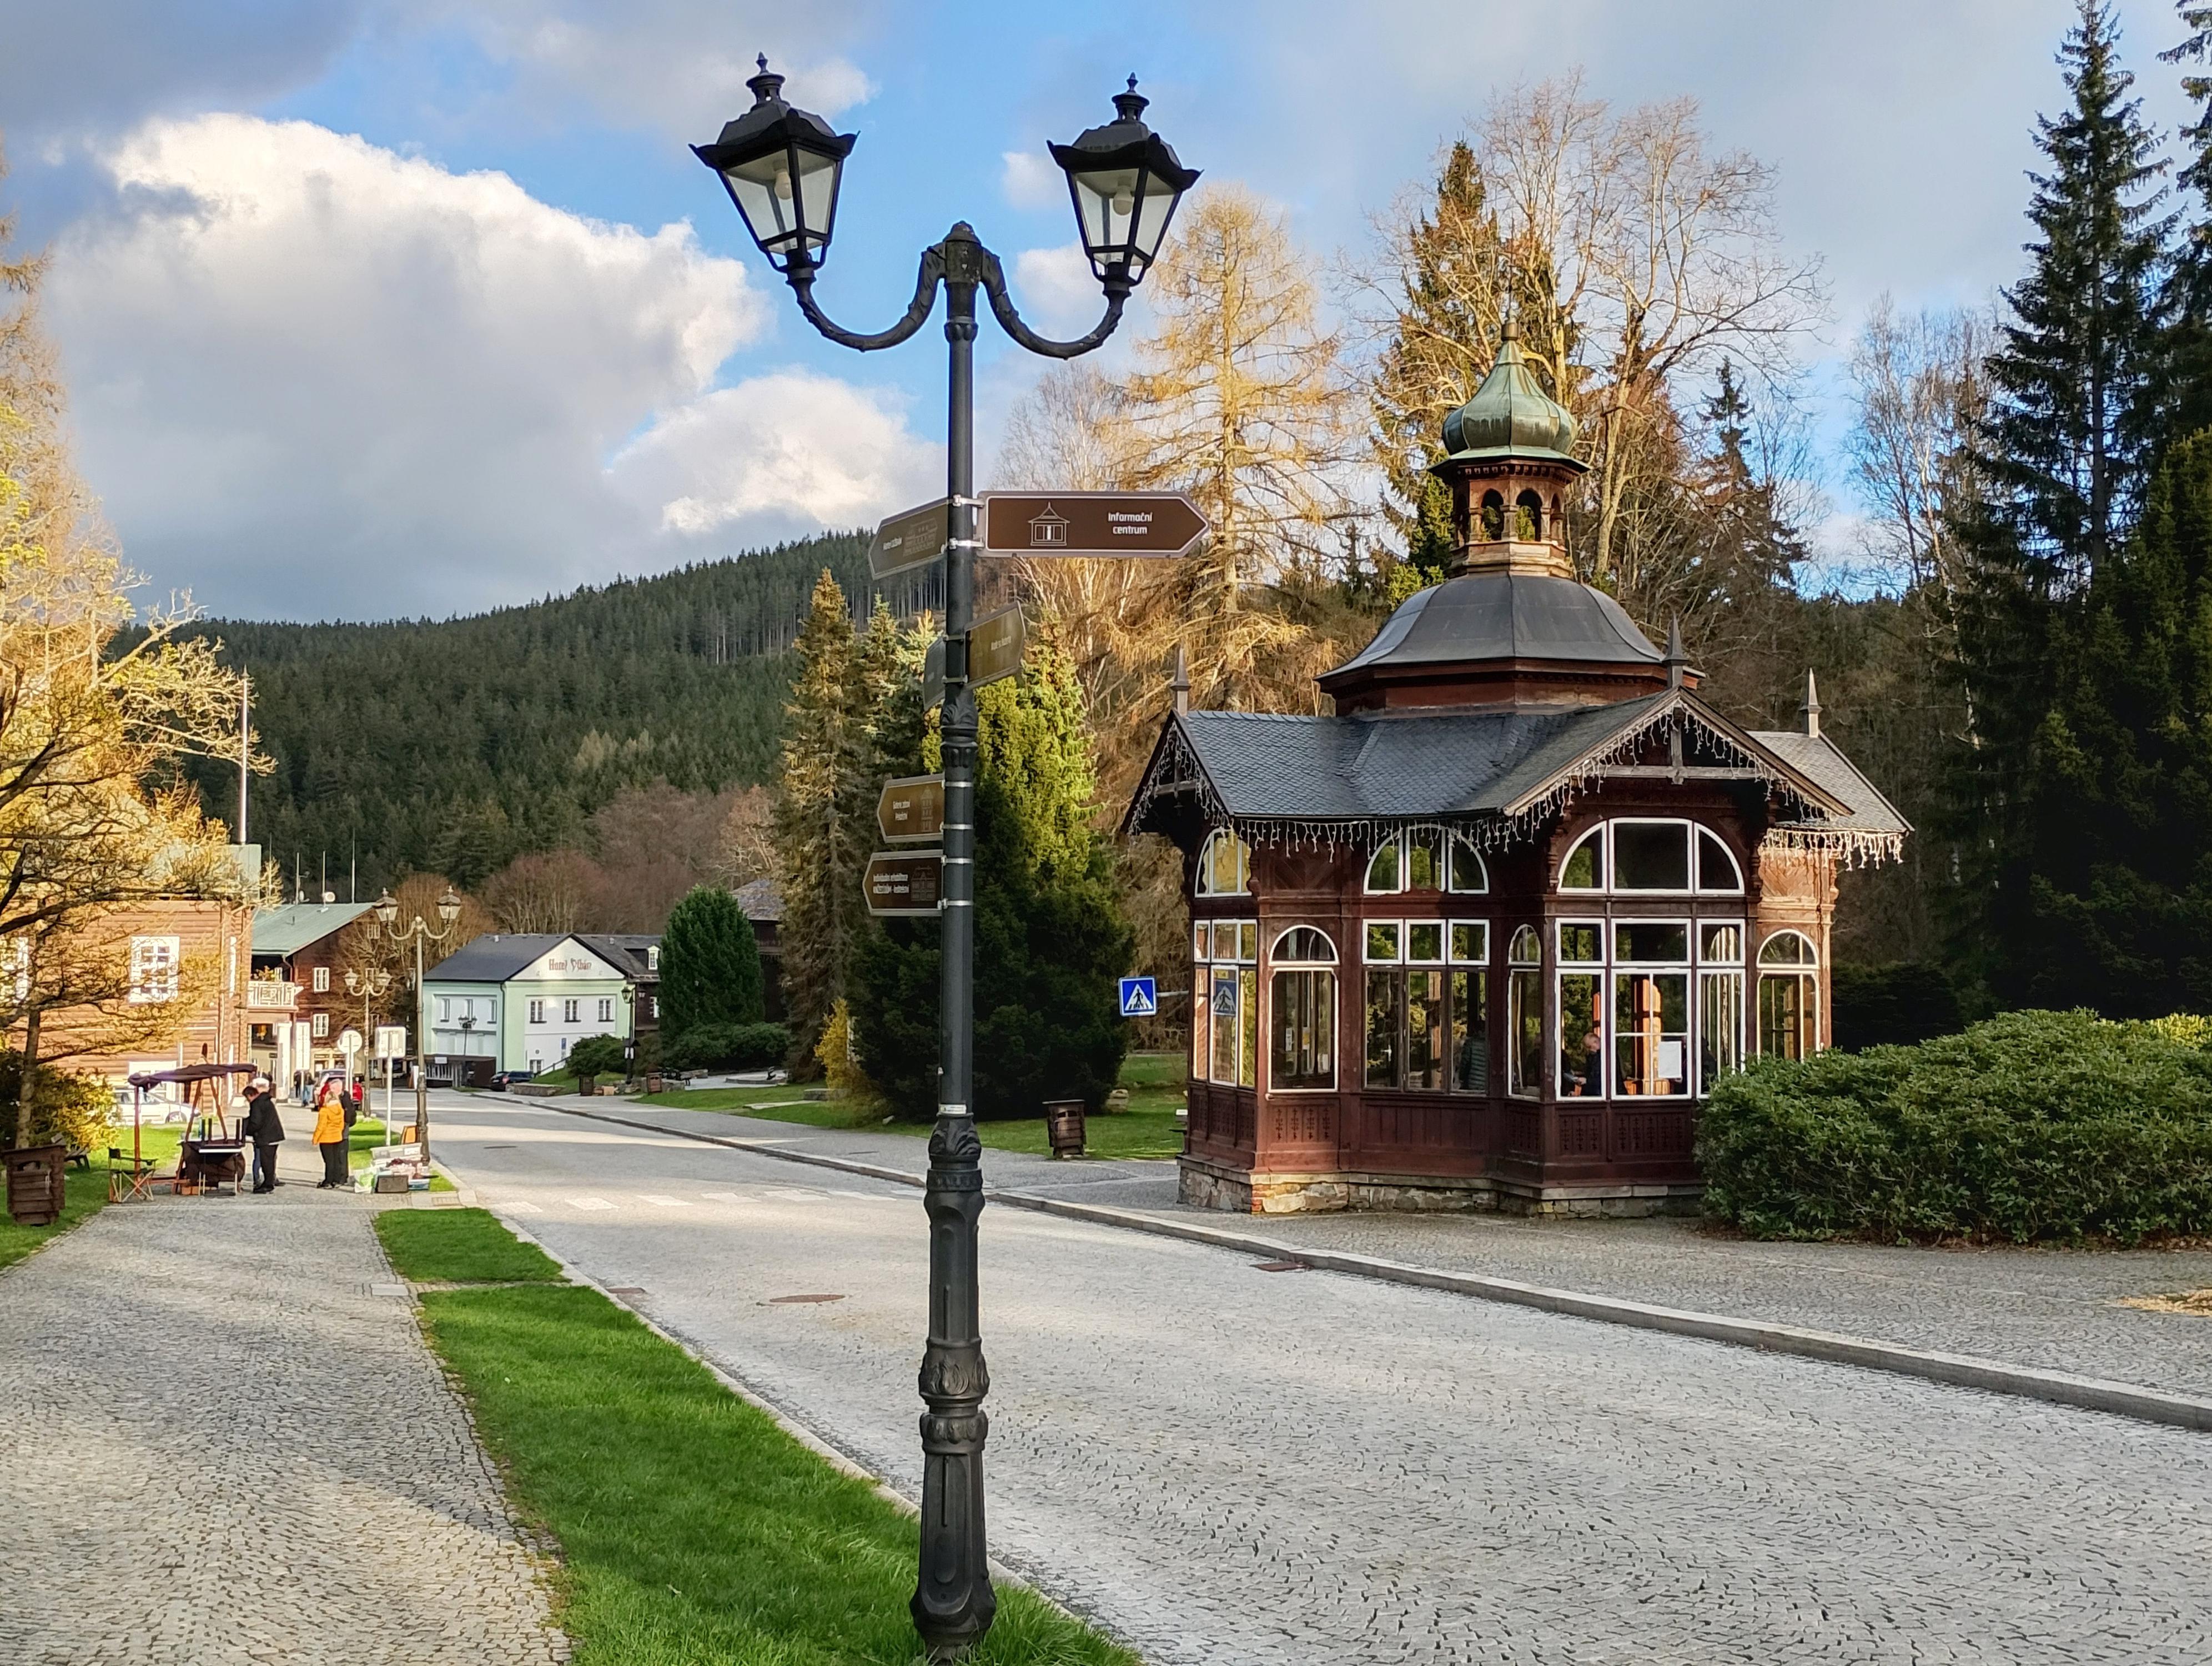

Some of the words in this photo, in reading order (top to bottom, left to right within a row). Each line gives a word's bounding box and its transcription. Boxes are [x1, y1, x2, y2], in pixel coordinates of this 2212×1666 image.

[1108, 512, 1153, 522] Informační
[1113, 525, 1148, 534] centrum
[549, 959, 567, 972] Hotel
